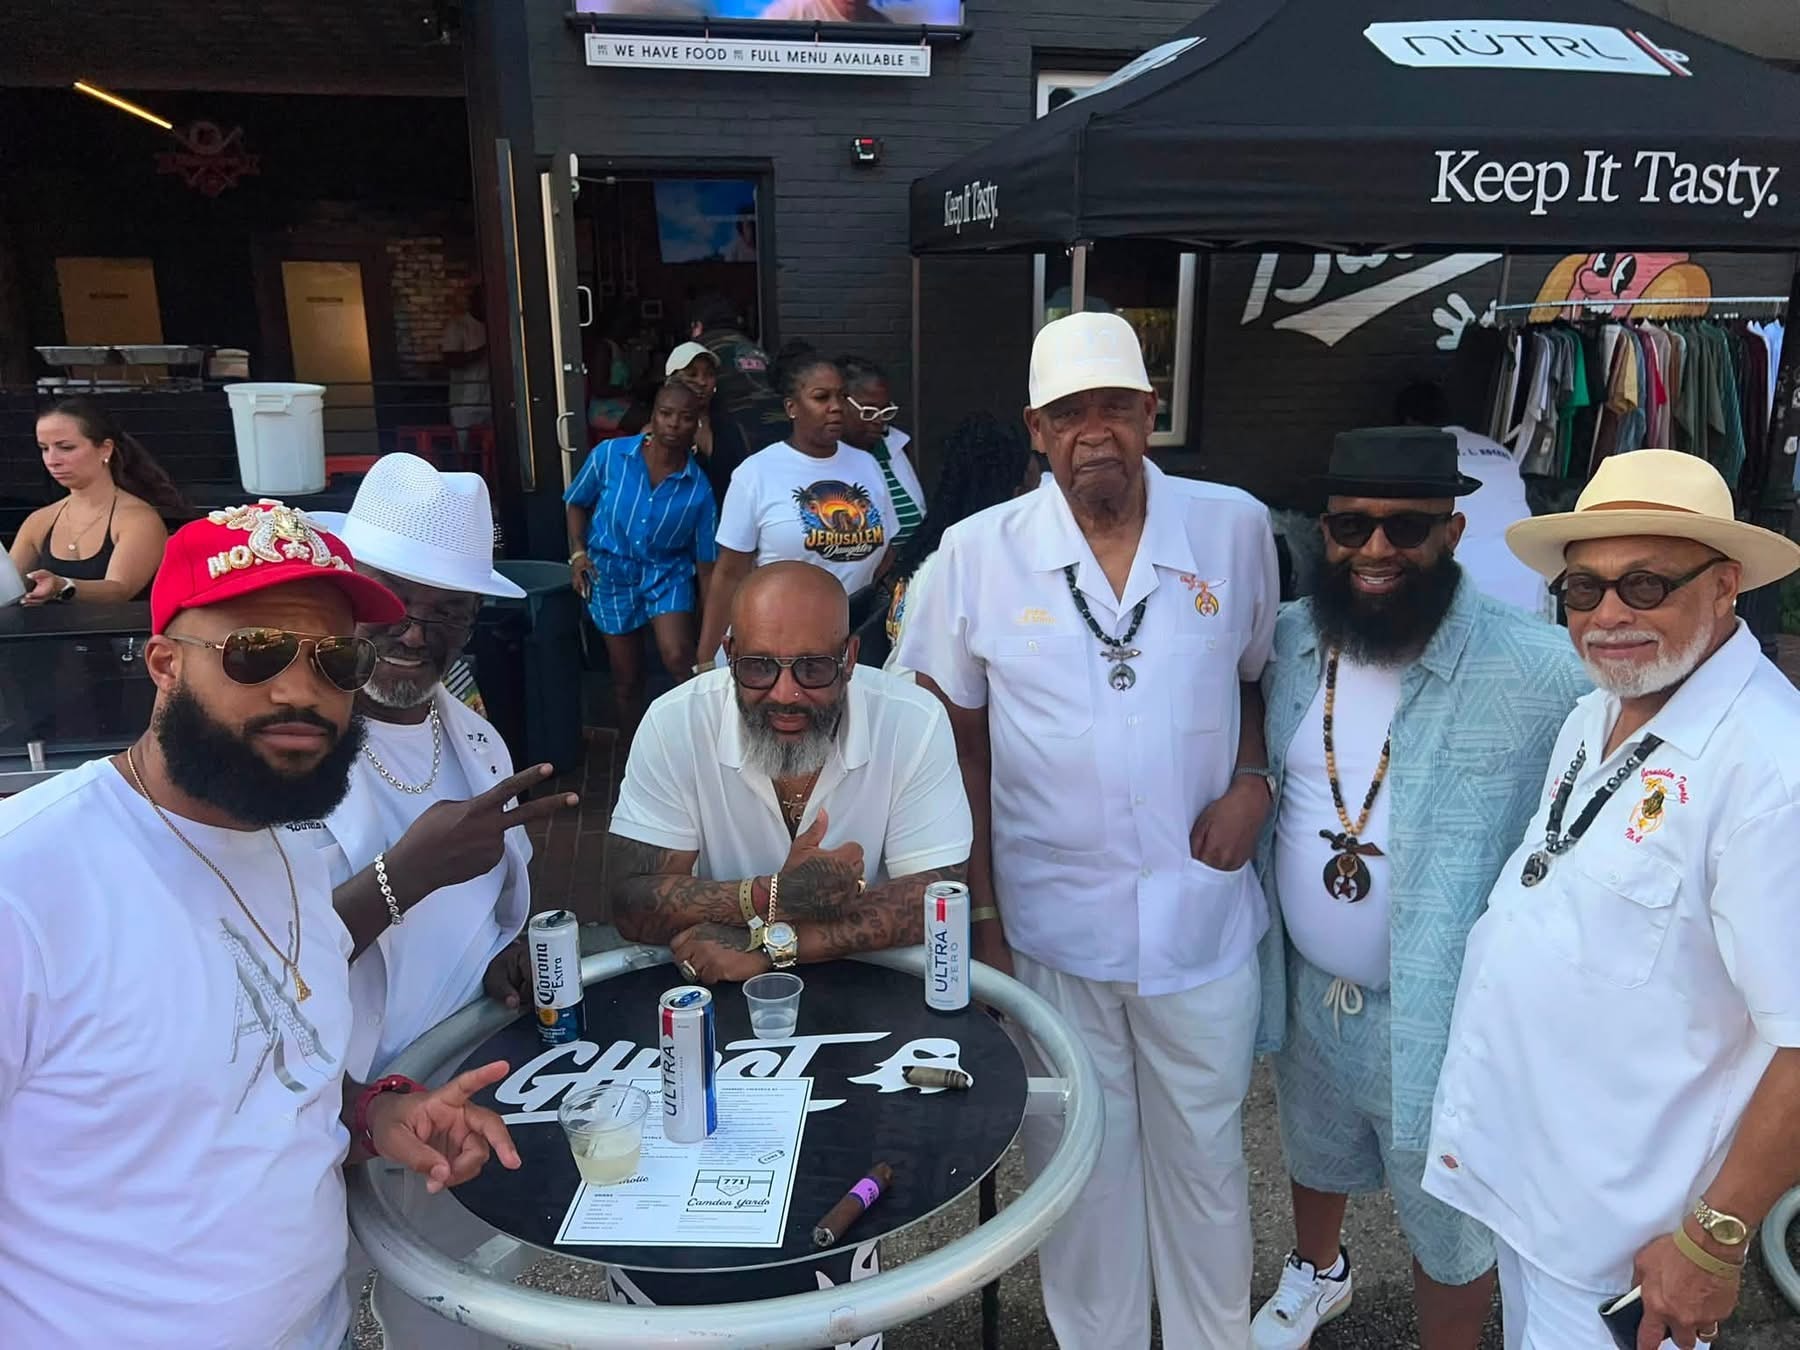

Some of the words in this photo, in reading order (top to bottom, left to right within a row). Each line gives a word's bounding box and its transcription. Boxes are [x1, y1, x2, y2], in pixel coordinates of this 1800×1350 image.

[614, 44, 635, 57] WE
[642, 45, 679, 59] HAVE
[686, 47, 727, 60] FOOD
[751, 49, 781, 62] FULL
[787, 50, 827, 63] MENU
[833, 53, 904, 66] AVAILABLE
[1430, 150, 1570, 215] Keep
[1577, 150, 1622, 202] It
[1634, 150, 1780, 218] Tasty.
[807, 526, 882, 547] JERUSALEM
[536, 943, 555, 1005] Corona
[552, 957, 564, 993] Extra
[935, 929, 949, 993] ULTRA
[951, 942, 959, 983] ZERO
[662, 1045, 678, 1117] ULTRA
[687, 1197, 732, 1207] Camden
[734, 1198, 770, 1209] Yards
